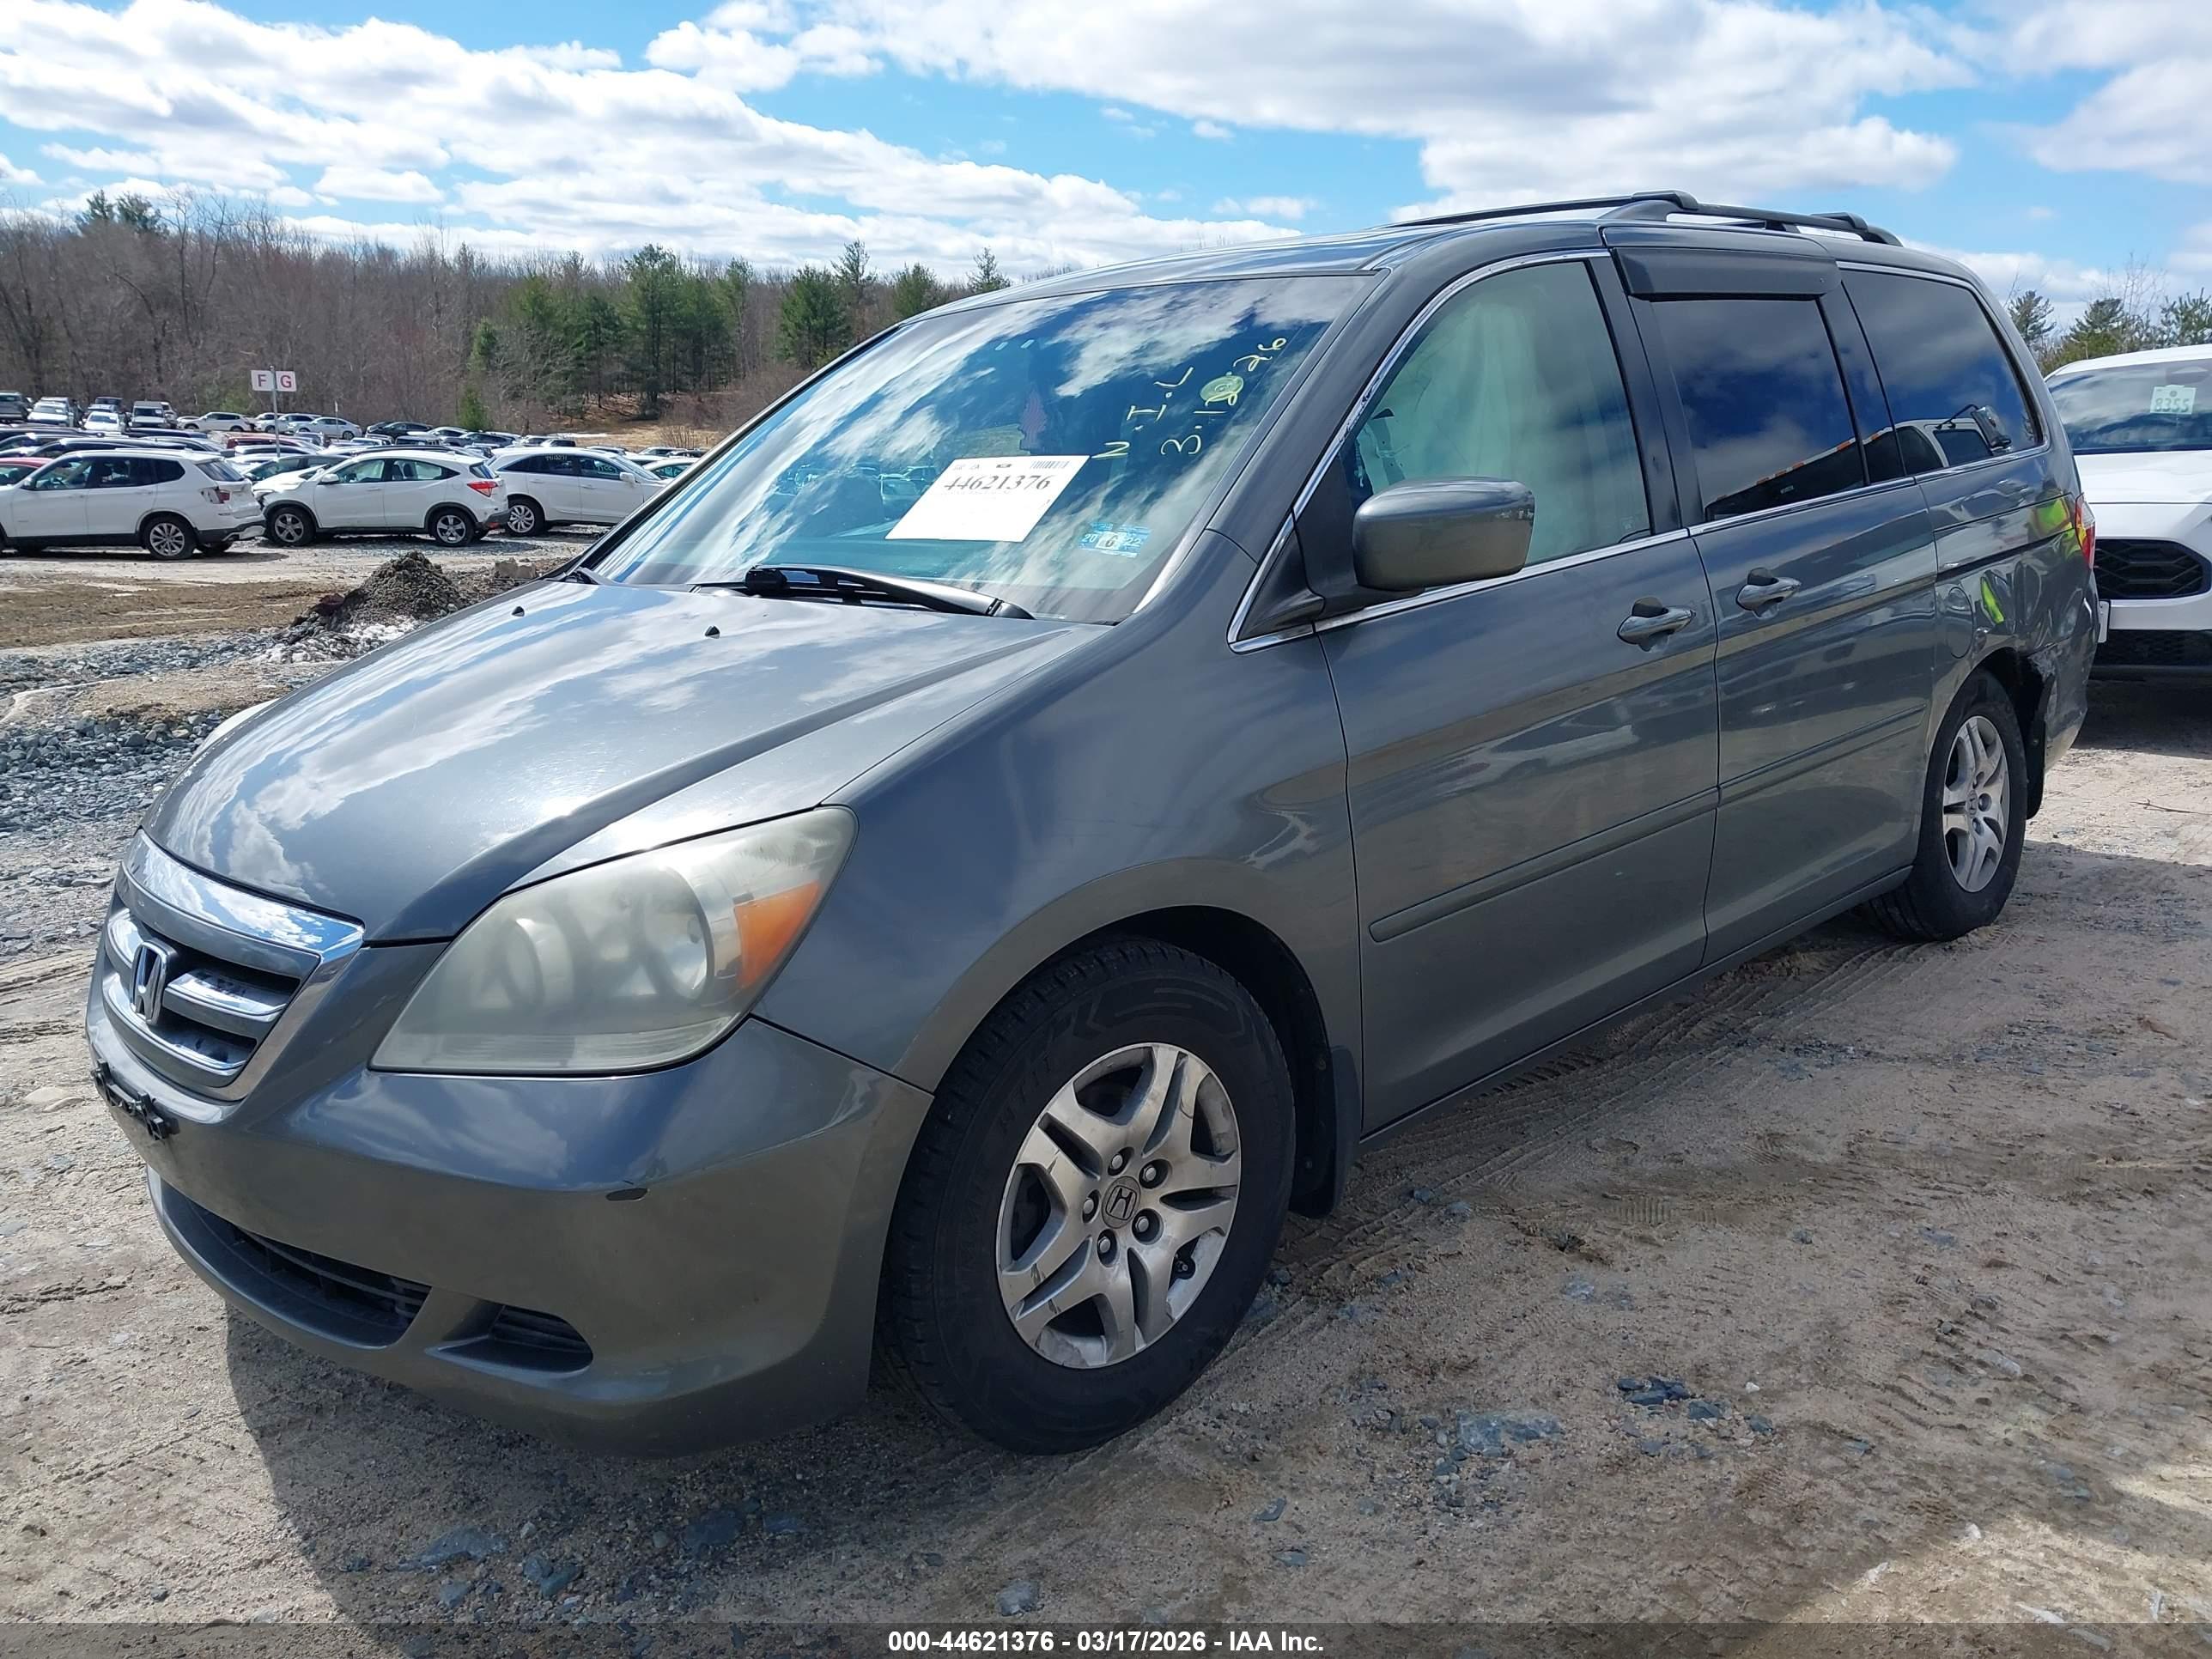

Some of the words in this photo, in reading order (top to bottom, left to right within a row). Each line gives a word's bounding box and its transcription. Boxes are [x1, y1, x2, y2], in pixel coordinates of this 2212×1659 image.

[258, 374, 267, 387] F
[280, 374, 292, 388] G
[944, 474, 1056, 491] 44621376
[1081, 533, 1099, 543] 20
[1105, 534, 1118, 548] 6
